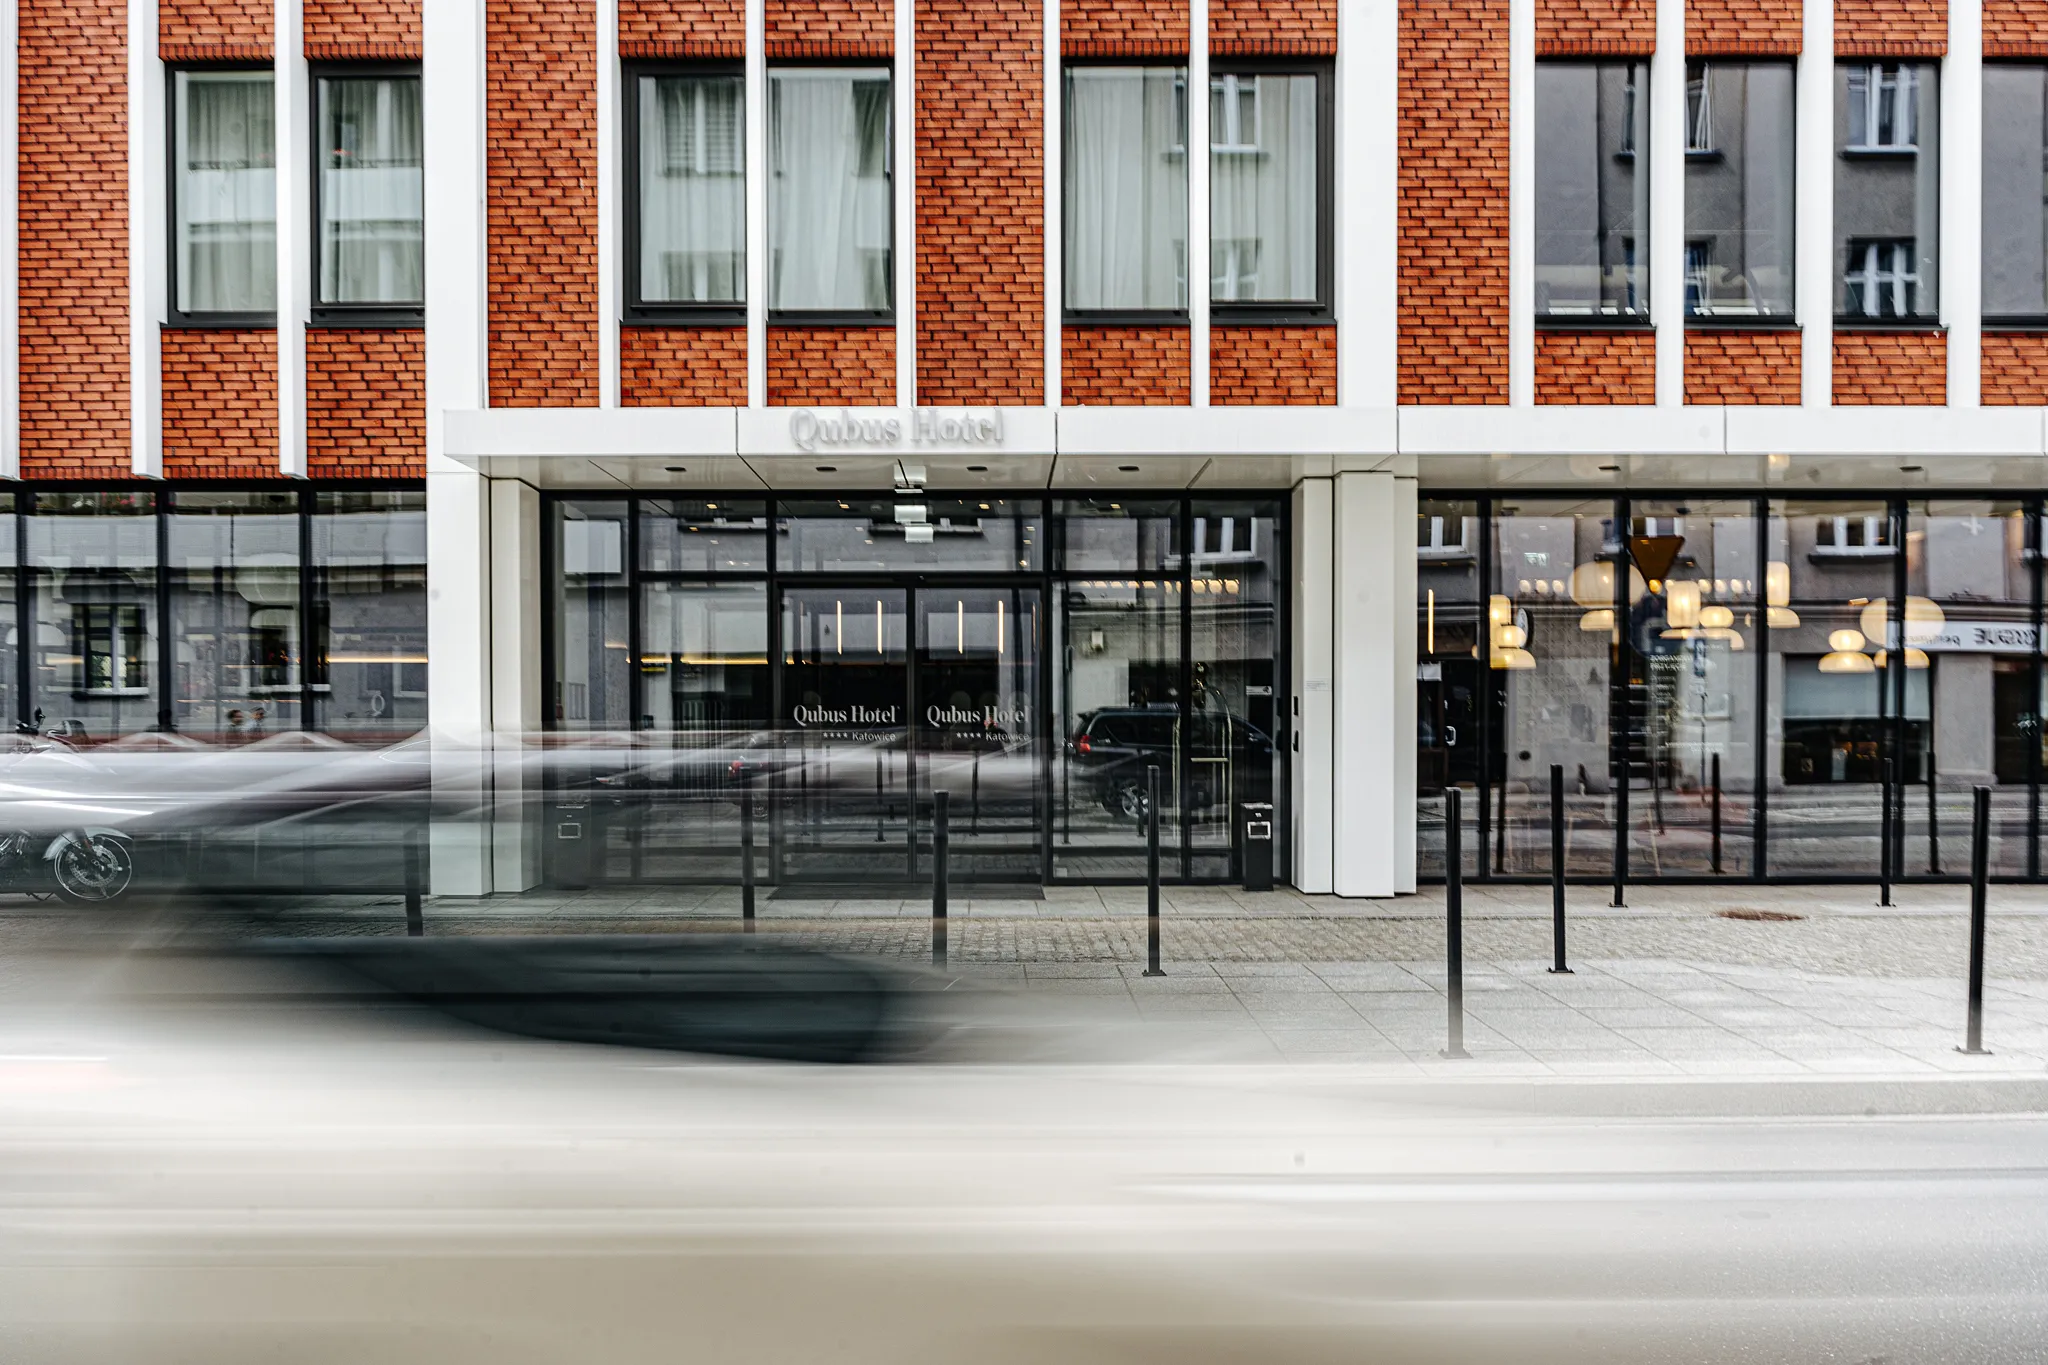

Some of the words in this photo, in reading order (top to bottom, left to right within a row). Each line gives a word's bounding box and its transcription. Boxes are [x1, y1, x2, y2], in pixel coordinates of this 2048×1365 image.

[789, 407, 901, 450] Qubus
[909, 407, 1004, 443] Hotel
[793, 704, 847, 727] Qubus
[851, 705, 896, 723] Hotel
[927, 704, 981, 728] Qubus
[984, 705, 1029, 723] Hotel
[852, 731, 896, 742] Katowice
[985, 731, 1030, 742] Katowice
